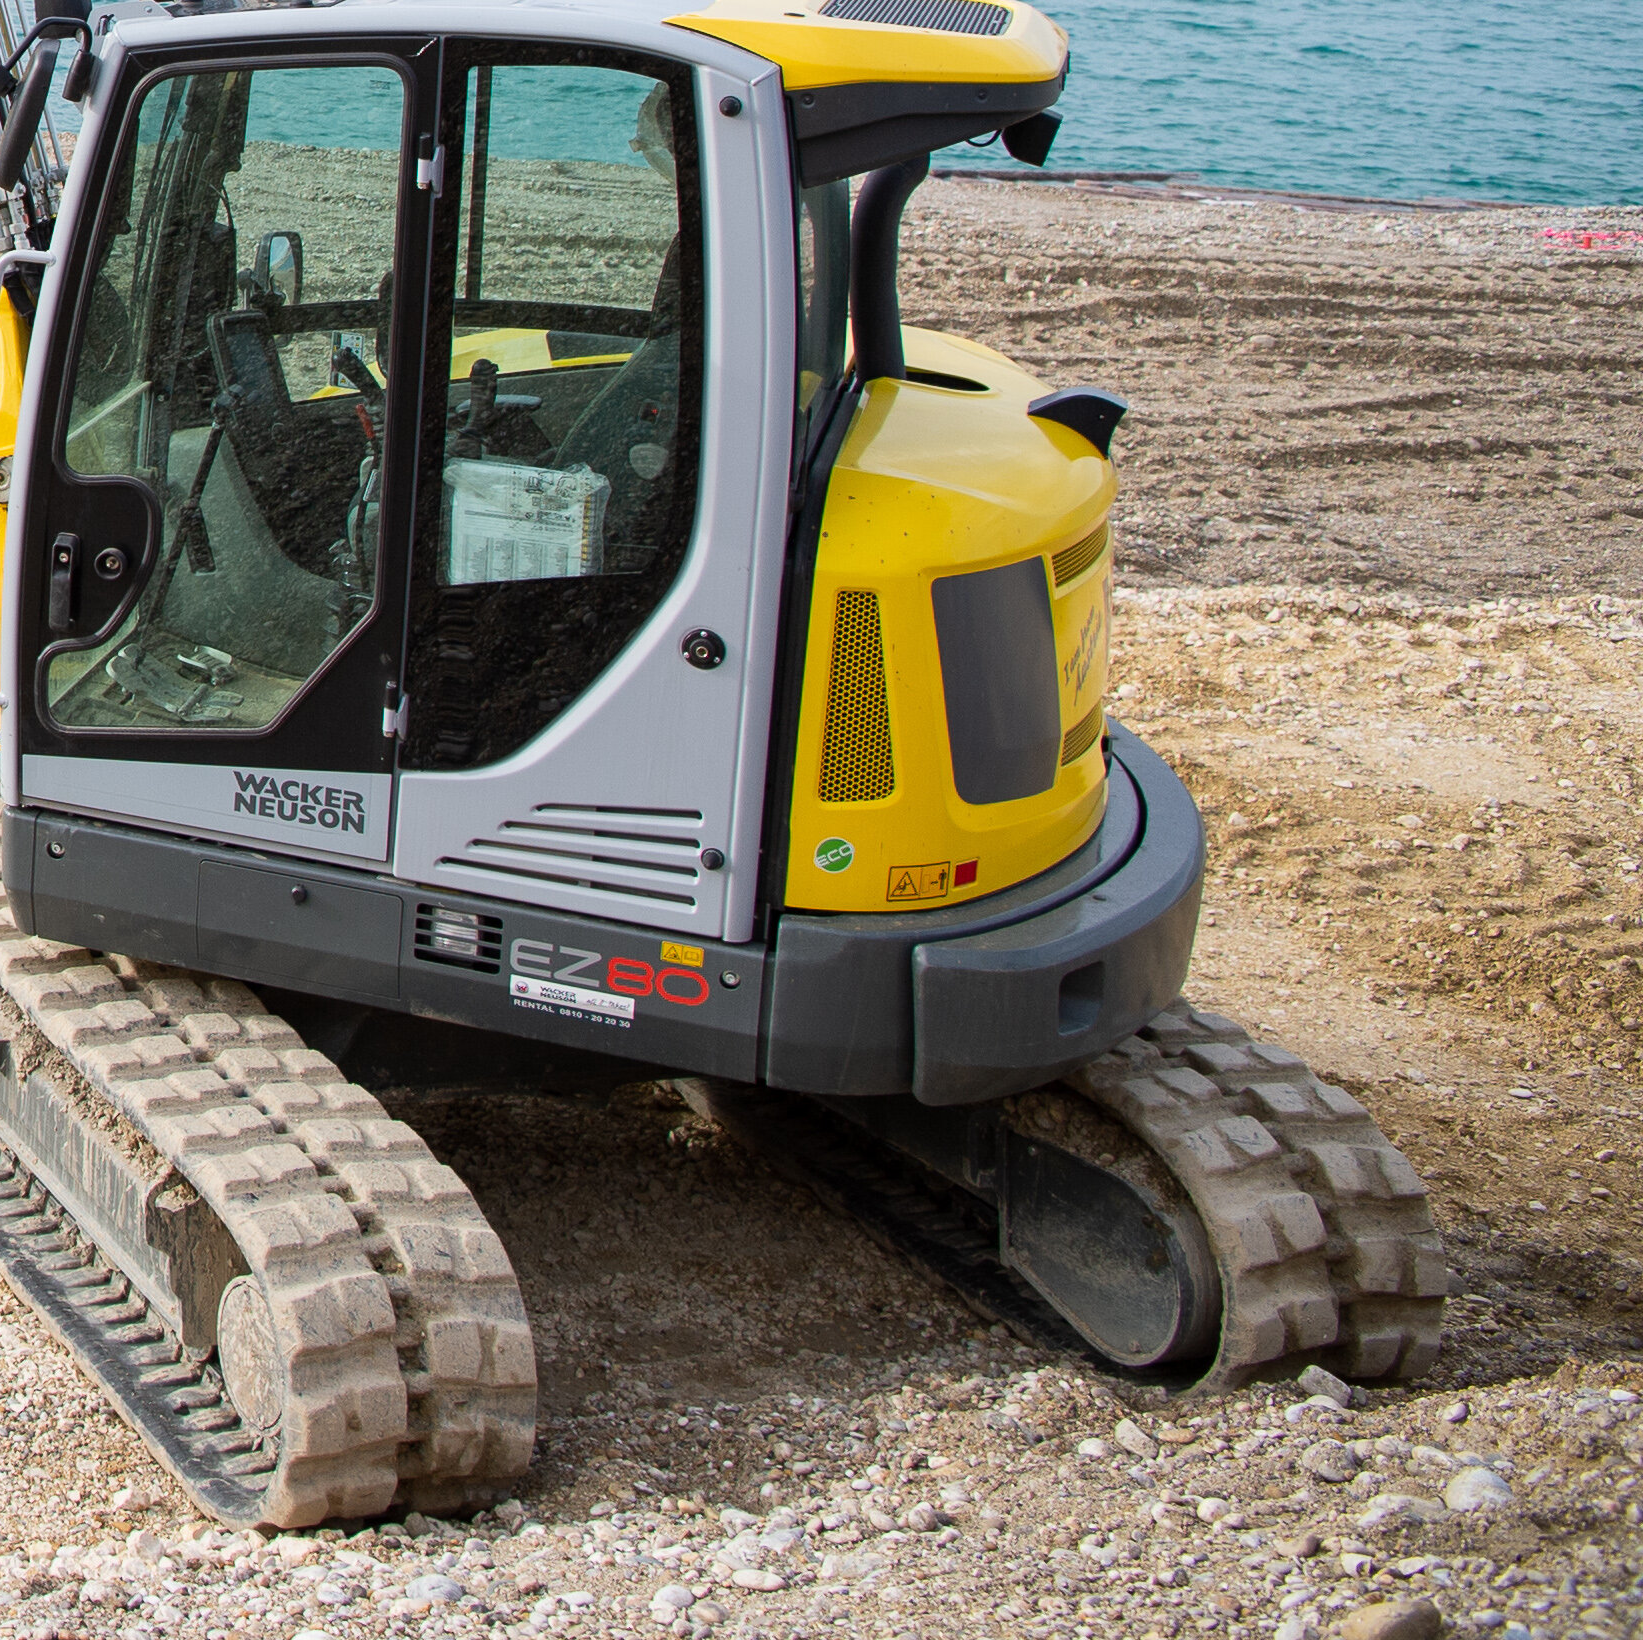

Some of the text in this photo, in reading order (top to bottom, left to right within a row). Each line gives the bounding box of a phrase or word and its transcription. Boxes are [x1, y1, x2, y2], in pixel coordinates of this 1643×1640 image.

[233, 770, 366, 813] WACKER
[234, 792, 365, 834] NEUSON
[814, 842, 855, 867] ECO
[510, 938, 710, 1006] EZ80
[540, 986, 577, 998] WACKER
[540, 992, 577, 1004] NEUSON
[514, 998, 555, 1013] RENTAL
[559, 1008, 583, 1019] 0810
[591, 1014, 603, 1023] 20
[604, 1017, 617, 1026] 20
[618, 1019, 631, 1029] 30
